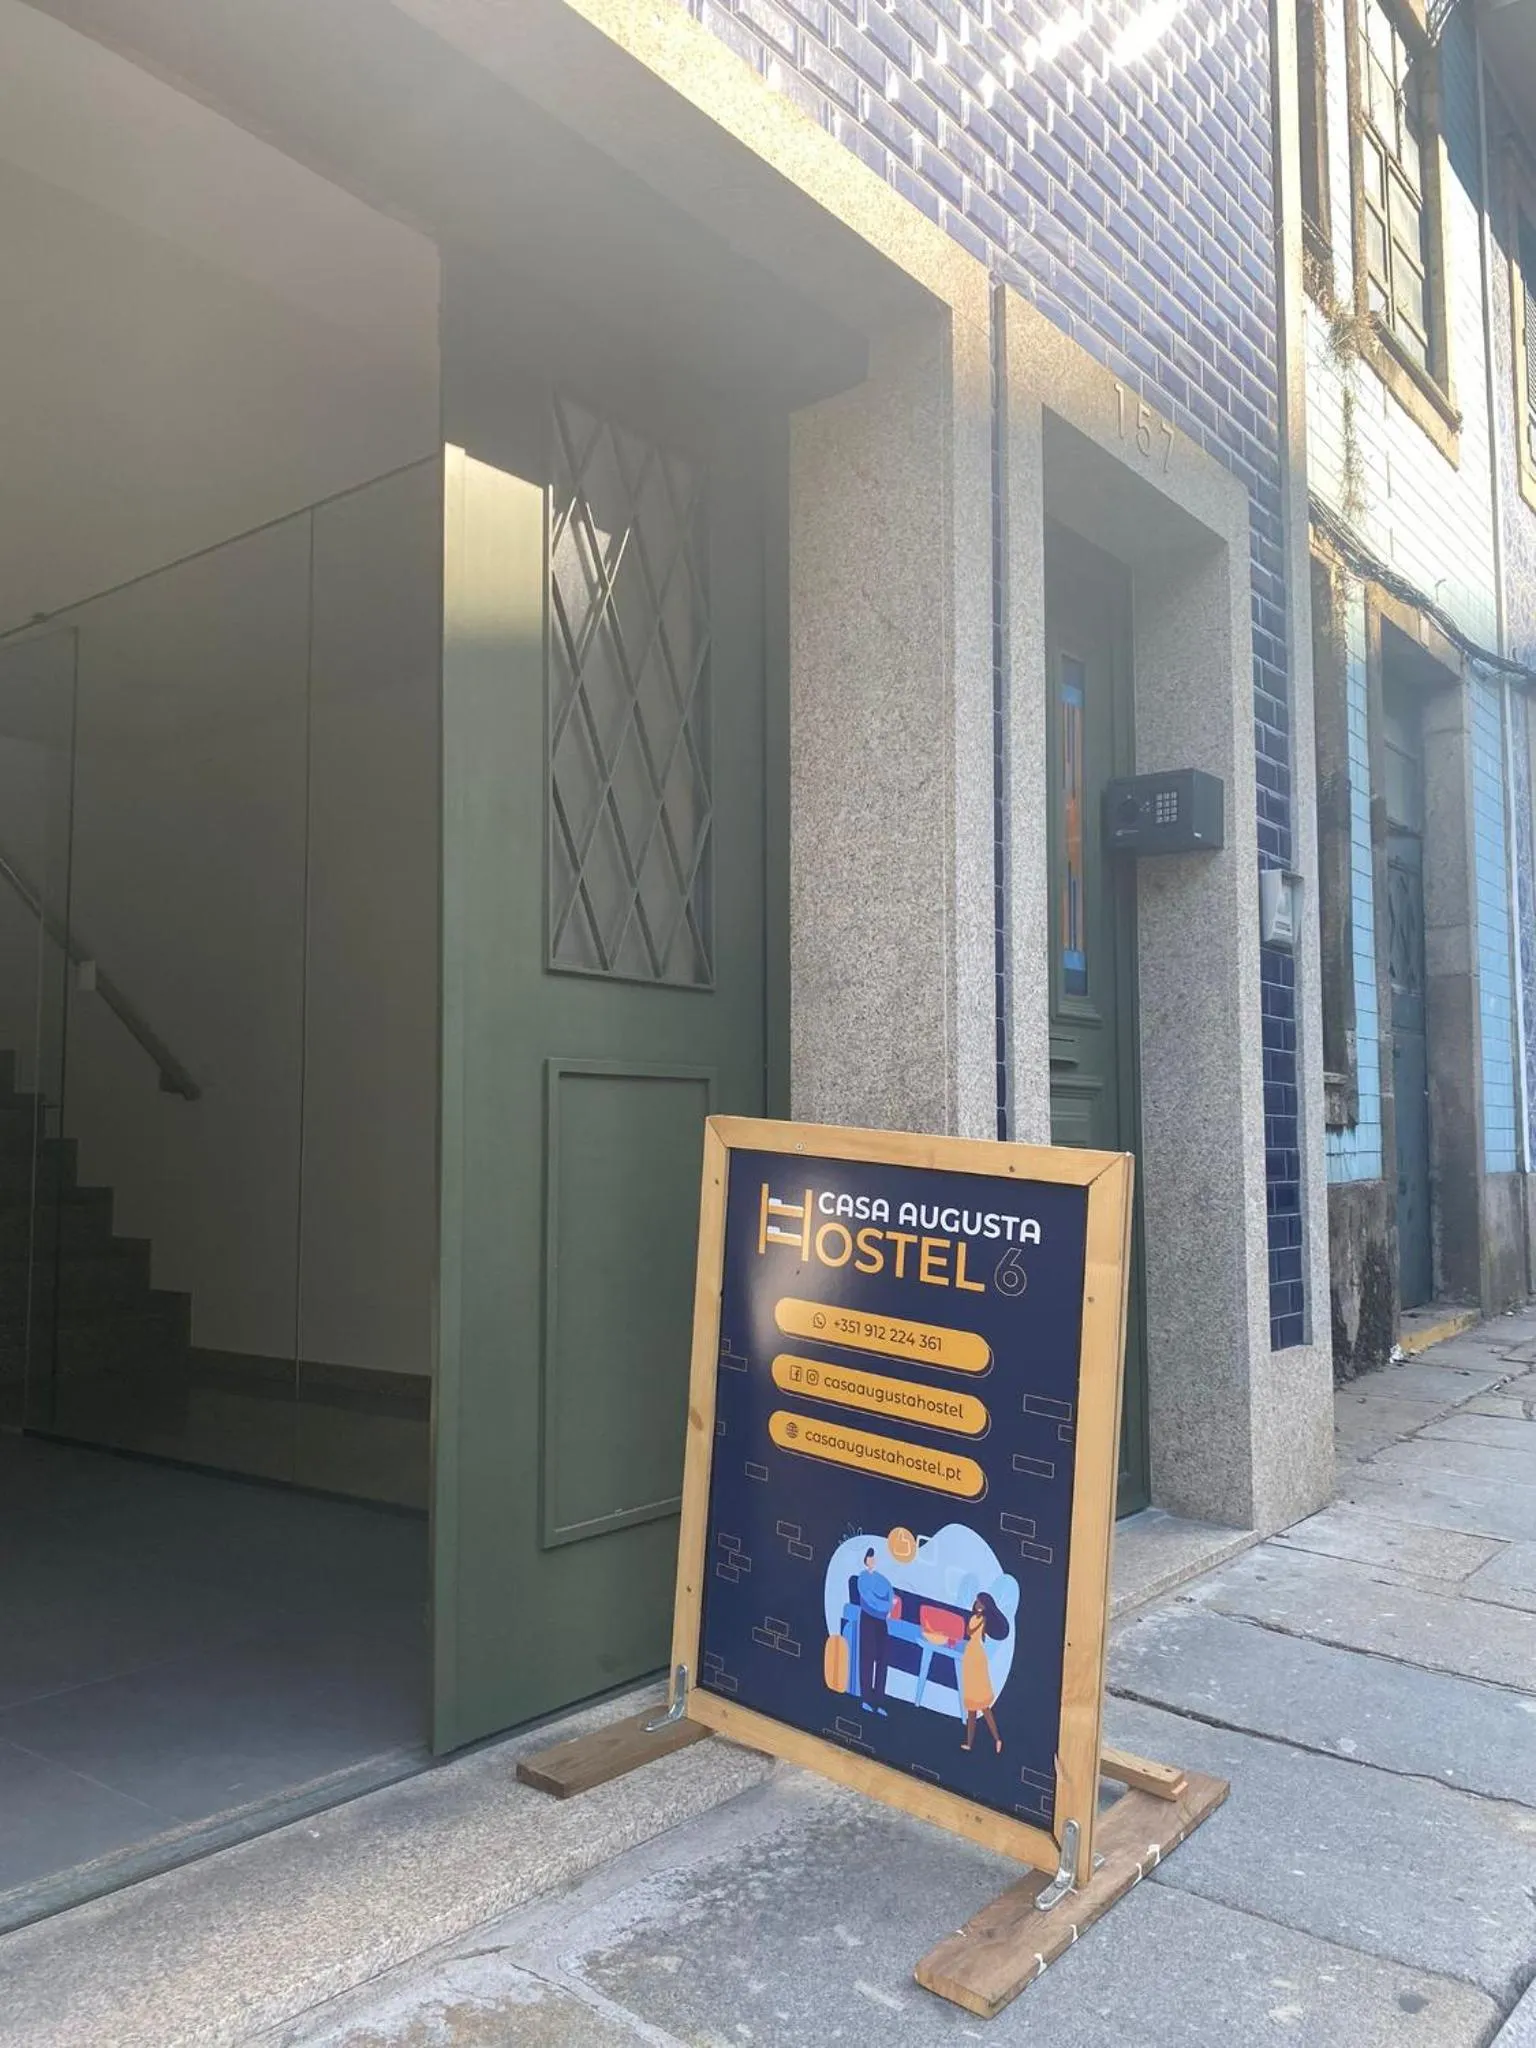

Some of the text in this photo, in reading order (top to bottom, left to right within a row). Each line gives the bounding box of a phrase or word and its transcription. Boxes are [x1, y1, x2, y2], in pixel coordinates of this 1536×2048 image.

[1113, 383, 1174, 473] 157
[758, 1183, 1028, 1297] HOSTEL 6
[818, 1191, 1042, 1245] CASA AUGUSTA
[833, 1316, 942, 1352] +351 912 224 361
[823, 1374, 964, 1420] casaaugustahostel
[804, 1429, 962, 1482] casaaugustahostel.pt
